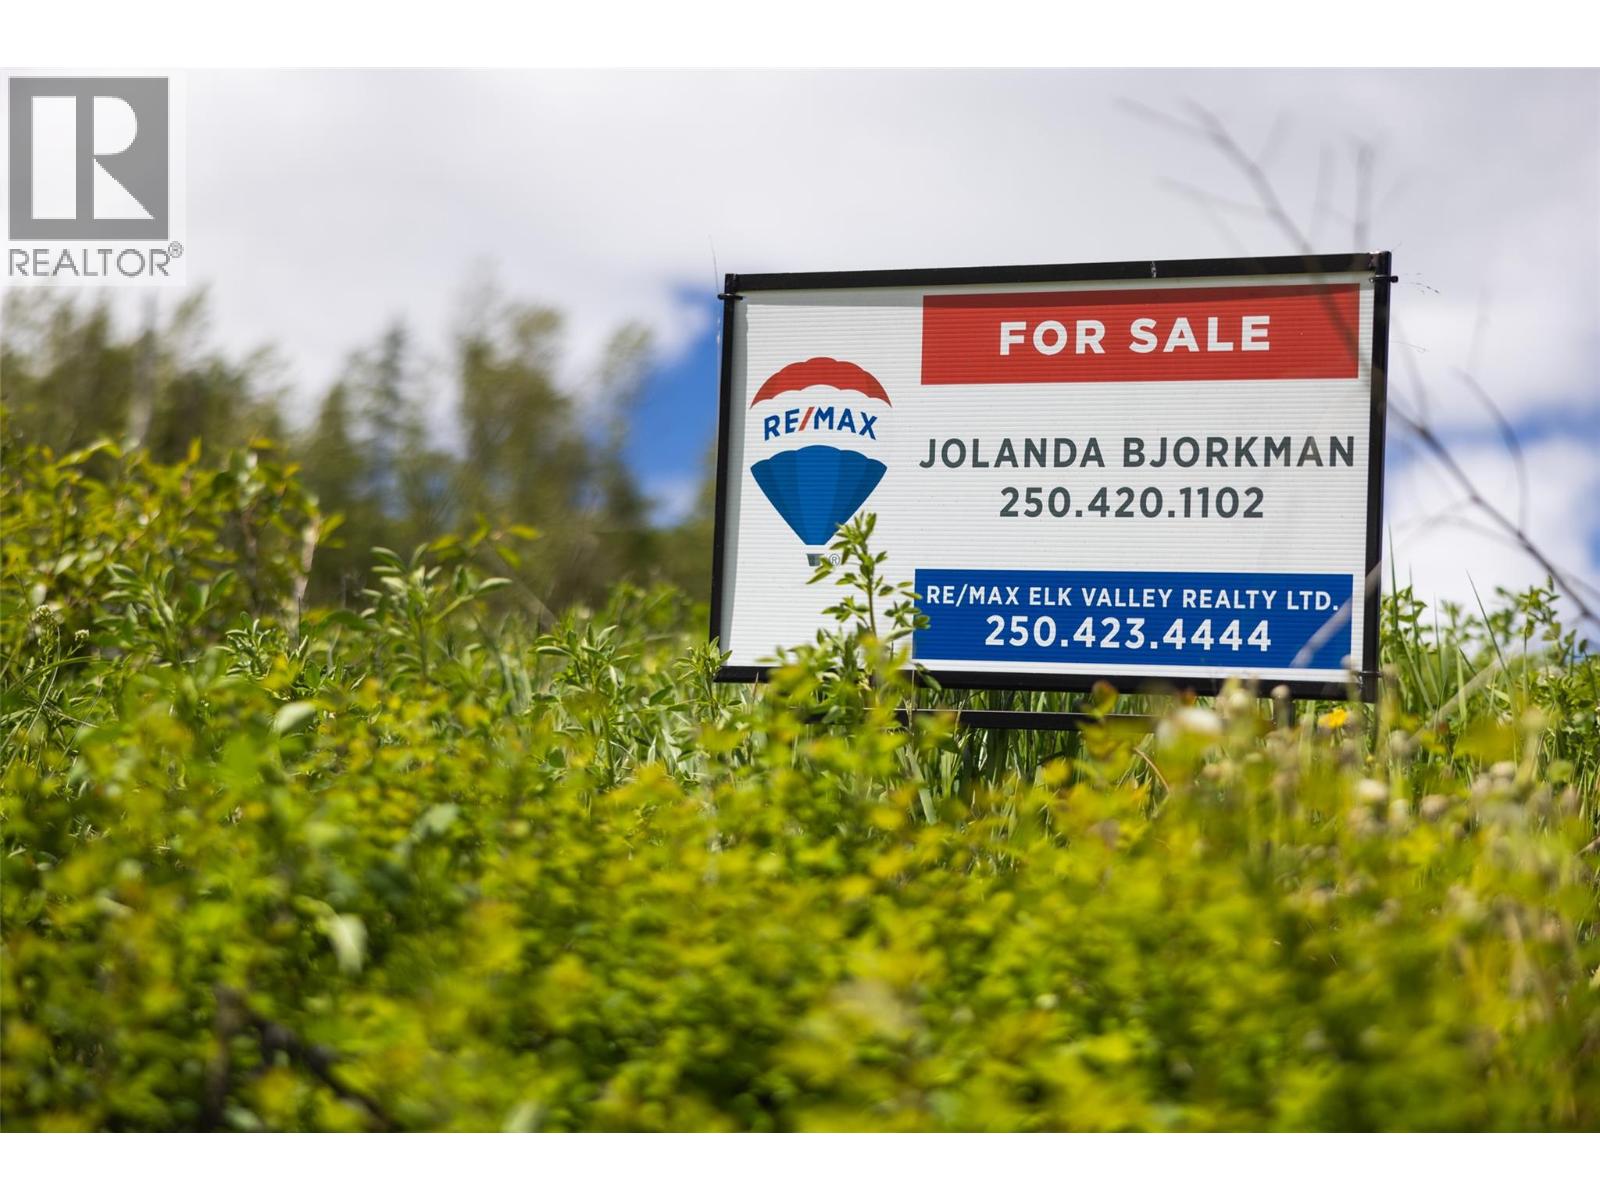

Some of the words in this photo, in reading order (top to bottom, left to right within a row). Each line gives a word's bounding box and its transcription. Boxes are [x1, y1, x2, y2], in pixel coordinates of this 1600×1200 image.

[1000, 320, 1106, 356] FOR
[1129, 315, 1271, 353] SALE
[763, 406, 878, 442] RE/MAX
[919, 437, 1105, 469] JOLANDA
[1123, 435, 1355, 468] BJORKMAN
[999, 486, 1265, 519] 250.420.1102
[926, 584, 1020, 608] RE/MAX
[1029, 587, 1072, 607] ELK
[1081, 588, 1173, 609] VALLEY
[1182, 589, 1278, 611] REALTY
[1286, 590, 1339, 612] LTD.
[984, 614, 1272, 652] 250.423.4444
